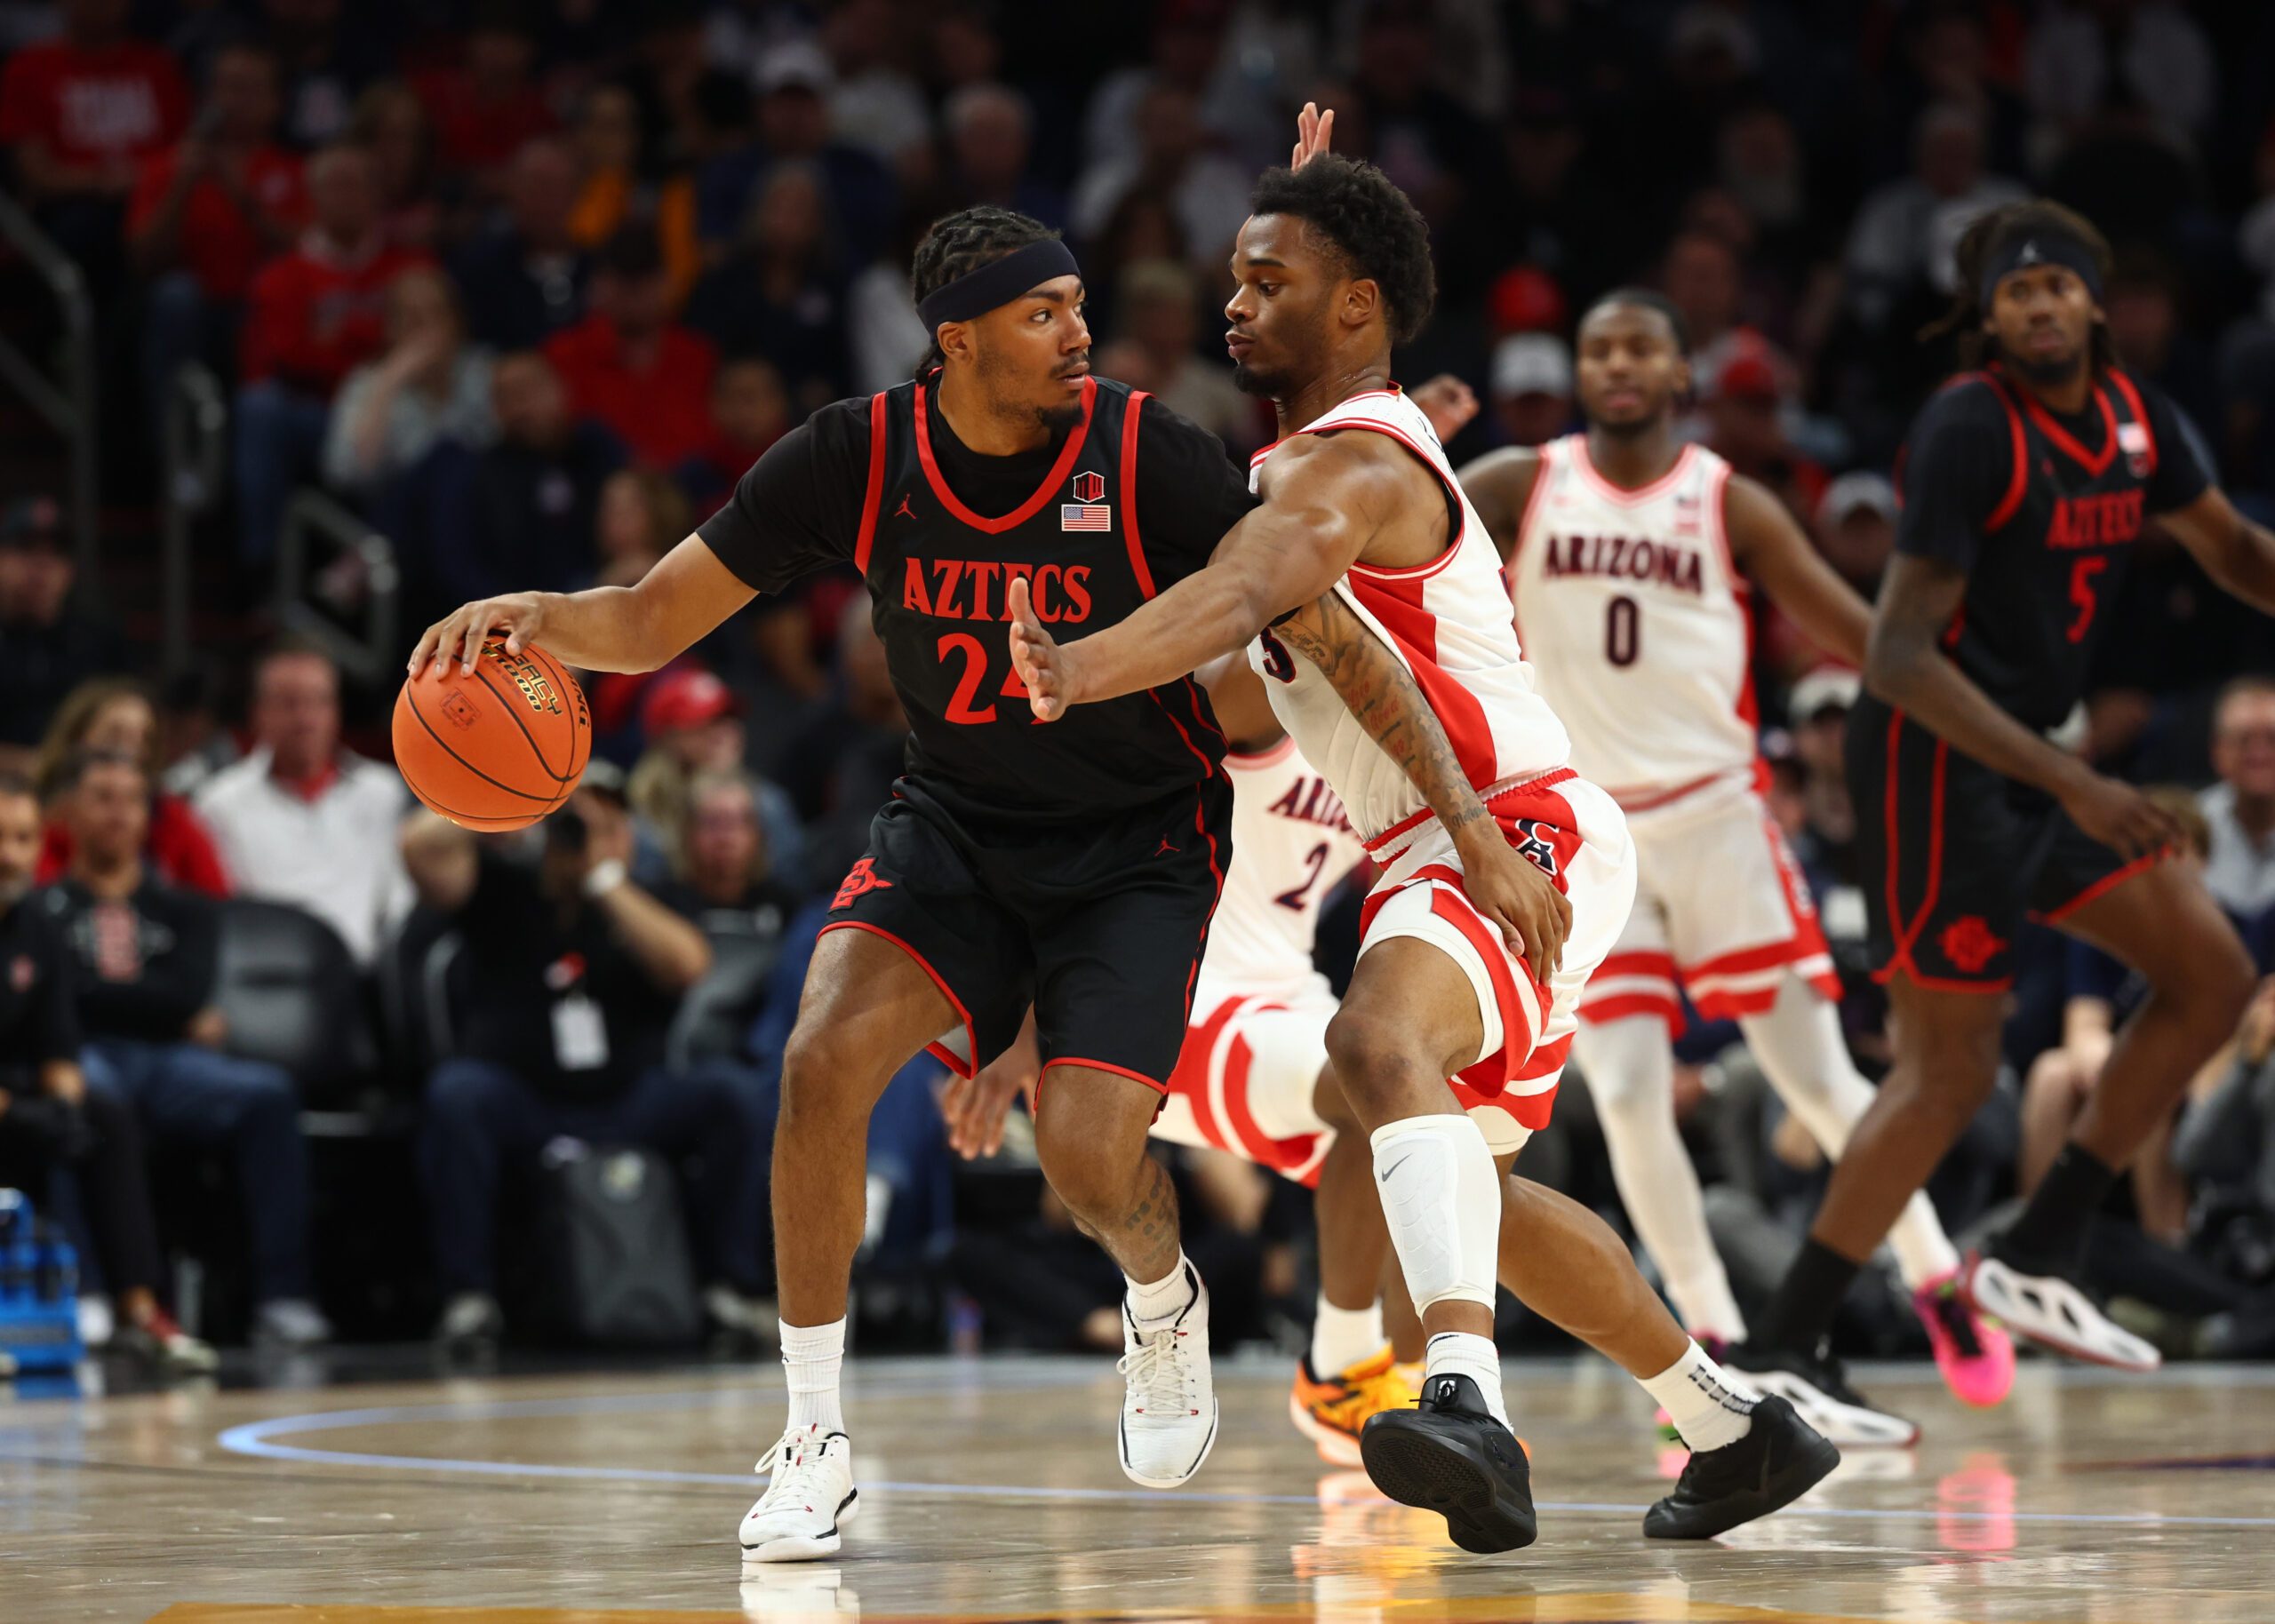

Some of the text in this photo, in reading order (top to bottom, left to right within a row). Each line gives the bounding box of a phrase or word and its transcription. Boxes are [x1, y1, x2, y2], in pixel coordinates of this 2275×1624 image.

[1544, 534, 1704, 595] ARIZONA
[2067, 554, 2107, 643] 5
[1607, 595, 1640, 667] 0
[1273, 841, 1329, 912] 2
